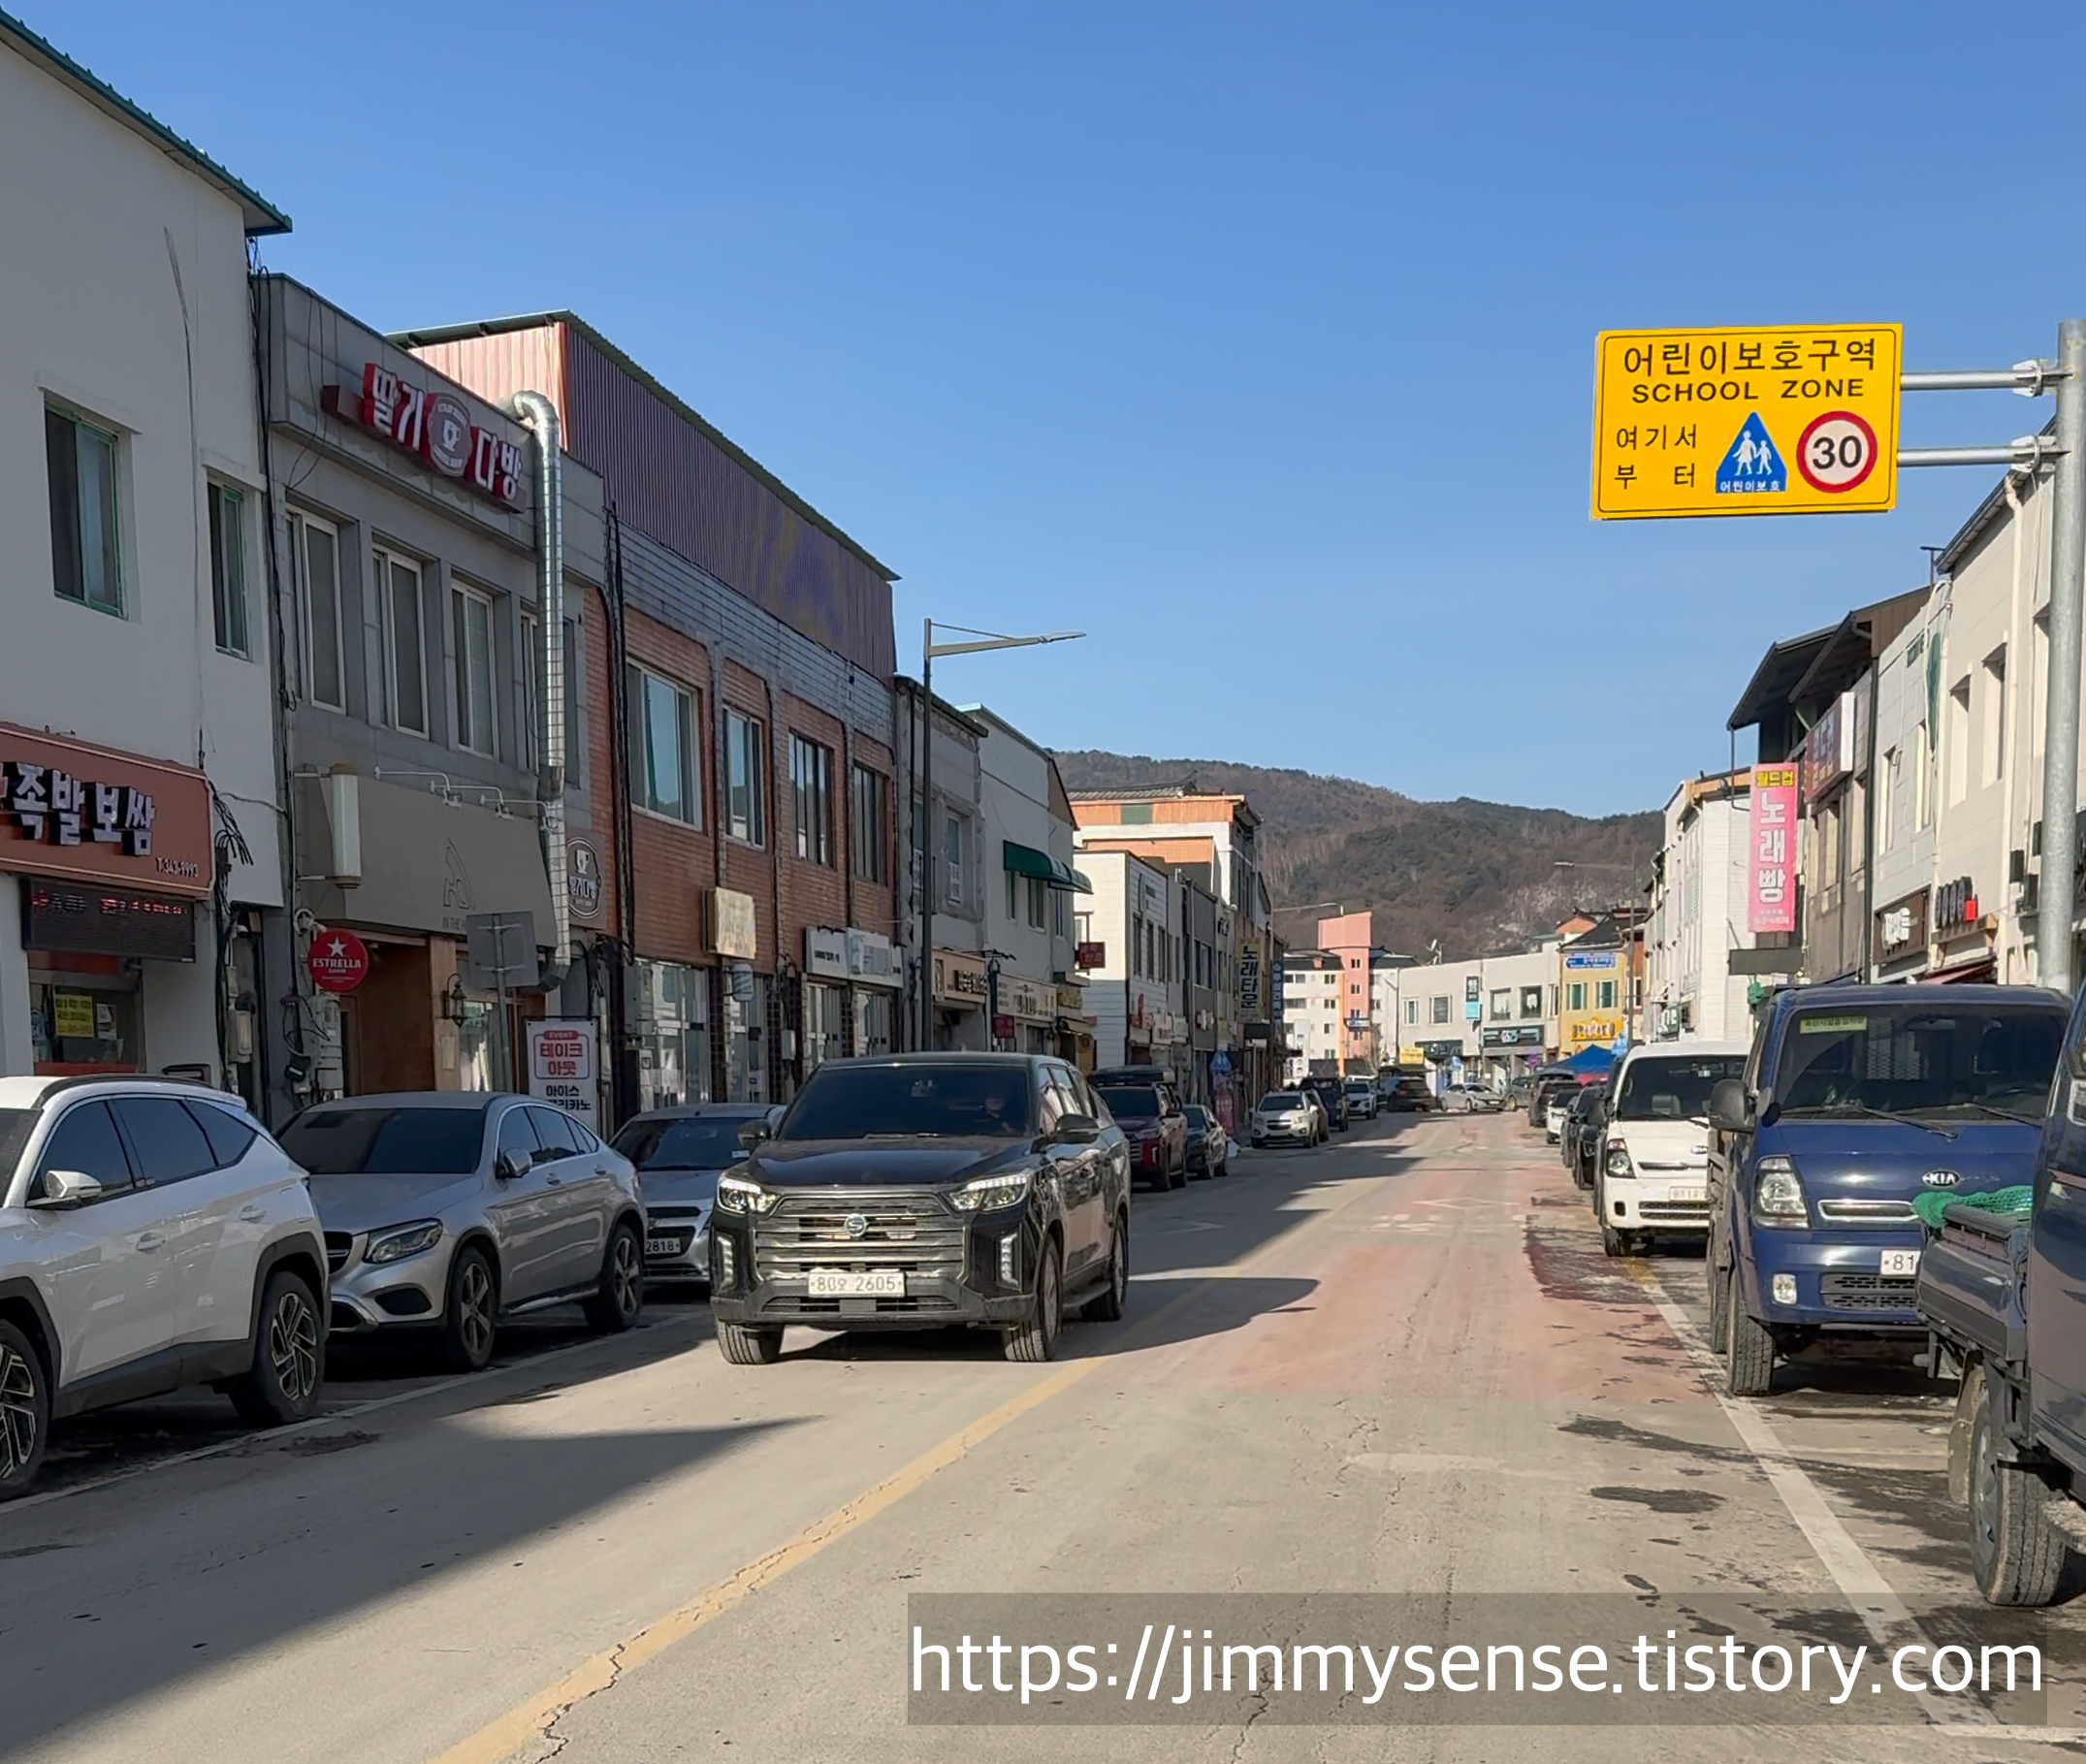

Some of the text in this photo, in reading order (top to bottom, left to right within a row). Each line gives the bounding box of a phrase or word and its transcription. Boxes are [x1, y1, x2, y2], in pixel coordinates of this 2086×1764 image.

[1624, 338, 1876, 376] 어린이보호구역
[1632, 379, 1864, 403] SCHOOL ZONE
[371, 364, 523, 500] 딸기 다방
[1616, 424, 1697, 450] 여기서
[1812, 434, 1863, 469] 30
[1719, 480, 1781, 493] 어린이보호
[13, 762, 156, 856] 족발보쌈
[312, 957, 362, 969] ESTRELLA
[1240, 946, 1259, 1009] 노래타운
[540, 1042, 583, 1058] 테이크
[548, 1060, 576, 1075] 아웃
[546, 1084, 579, 1097] 아이스
[1930, 1172, 1956, 1184] KIA
[646, 1240, 674, 1252] 2818
[1893, 1254, 1914, 1270] 81
[855, 1275, 895, 1291] 2605
